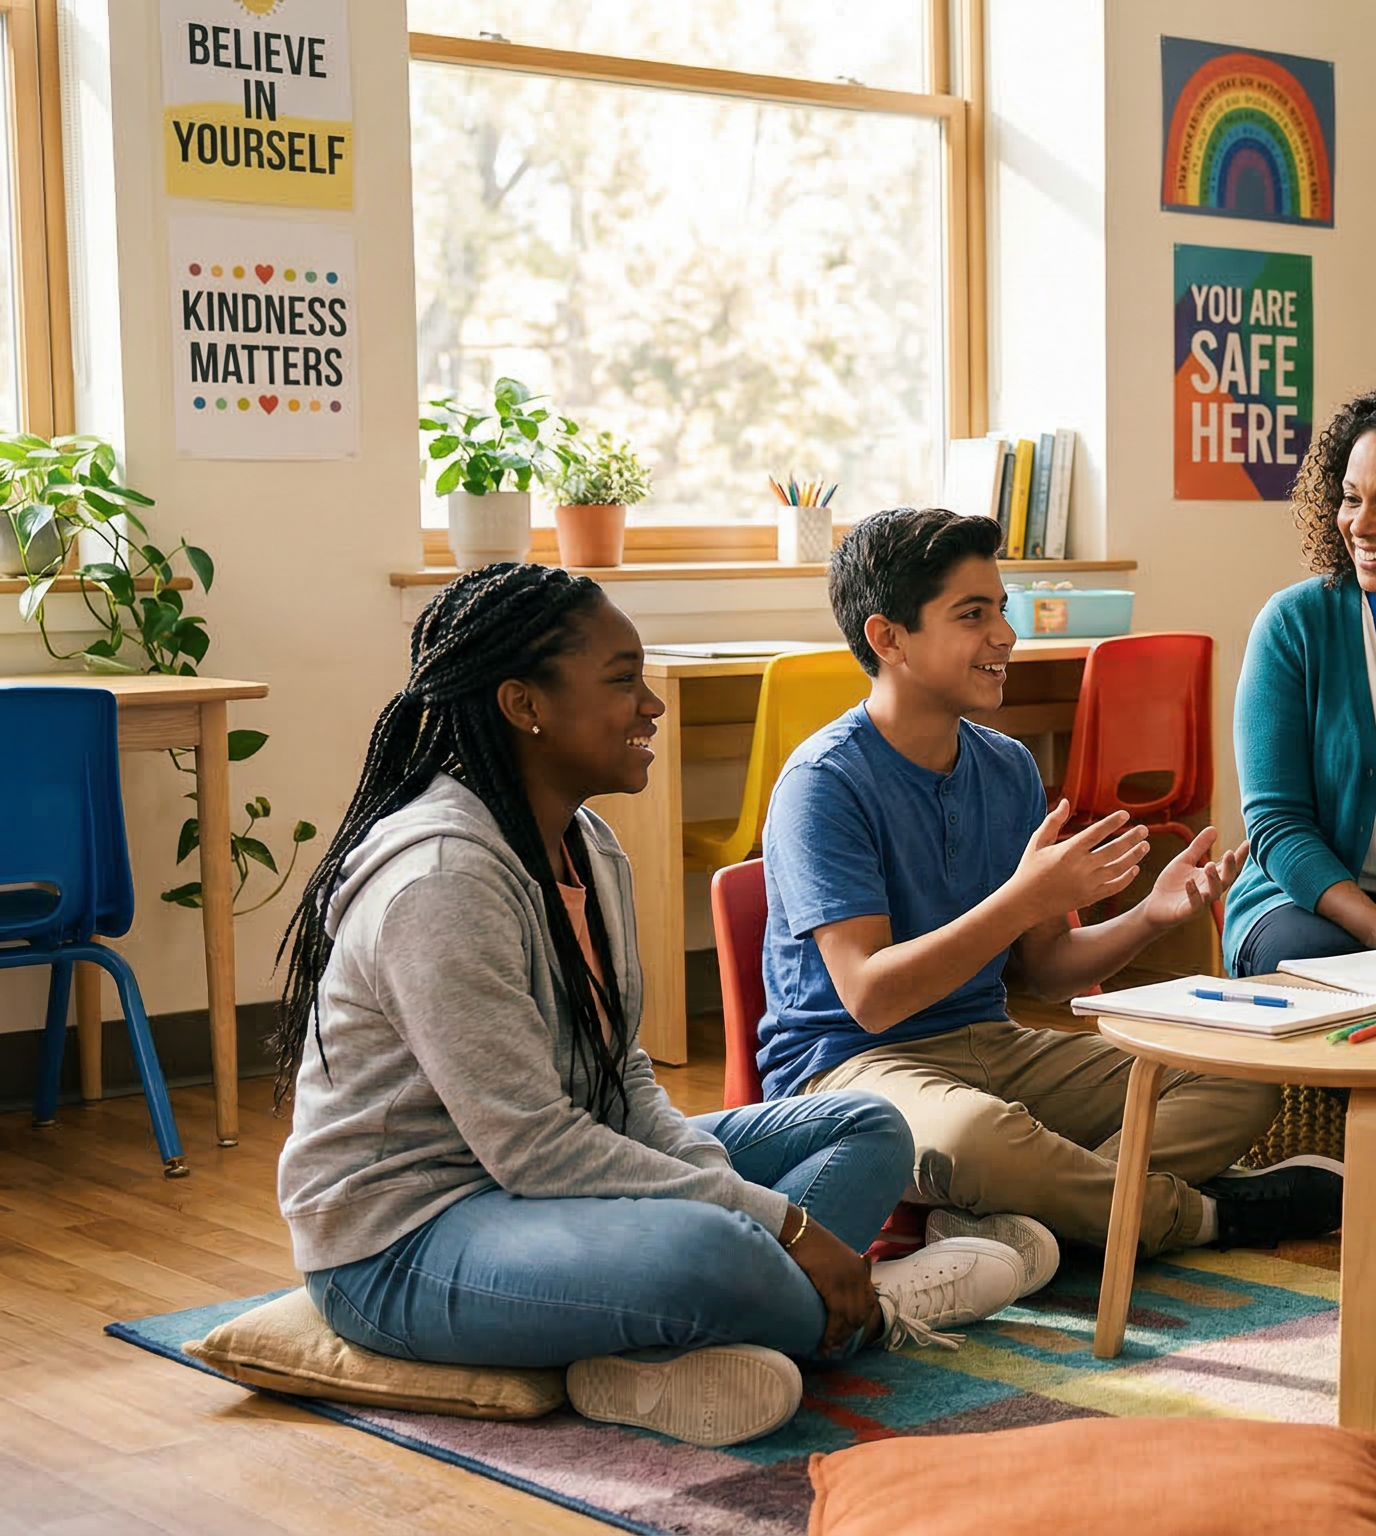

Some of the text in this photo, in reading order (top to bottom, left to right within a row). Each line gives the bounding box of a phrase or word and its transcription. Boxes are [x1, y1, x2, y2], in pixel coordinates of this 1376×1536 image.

[188, 22, 327, 79] BELIEVE
[243, 78, 277, 122] IN
[172, 119, 345, 175] YOURSELF
[182, 289, 347, 338] KINDNESS
[1191, 284, 1297, 328] YOU ARE
[190, 341, 343, 387] MATTERS
[1190, 329, 1298, 397] SAFE
[1191, 401, 1298, 465] HERE
